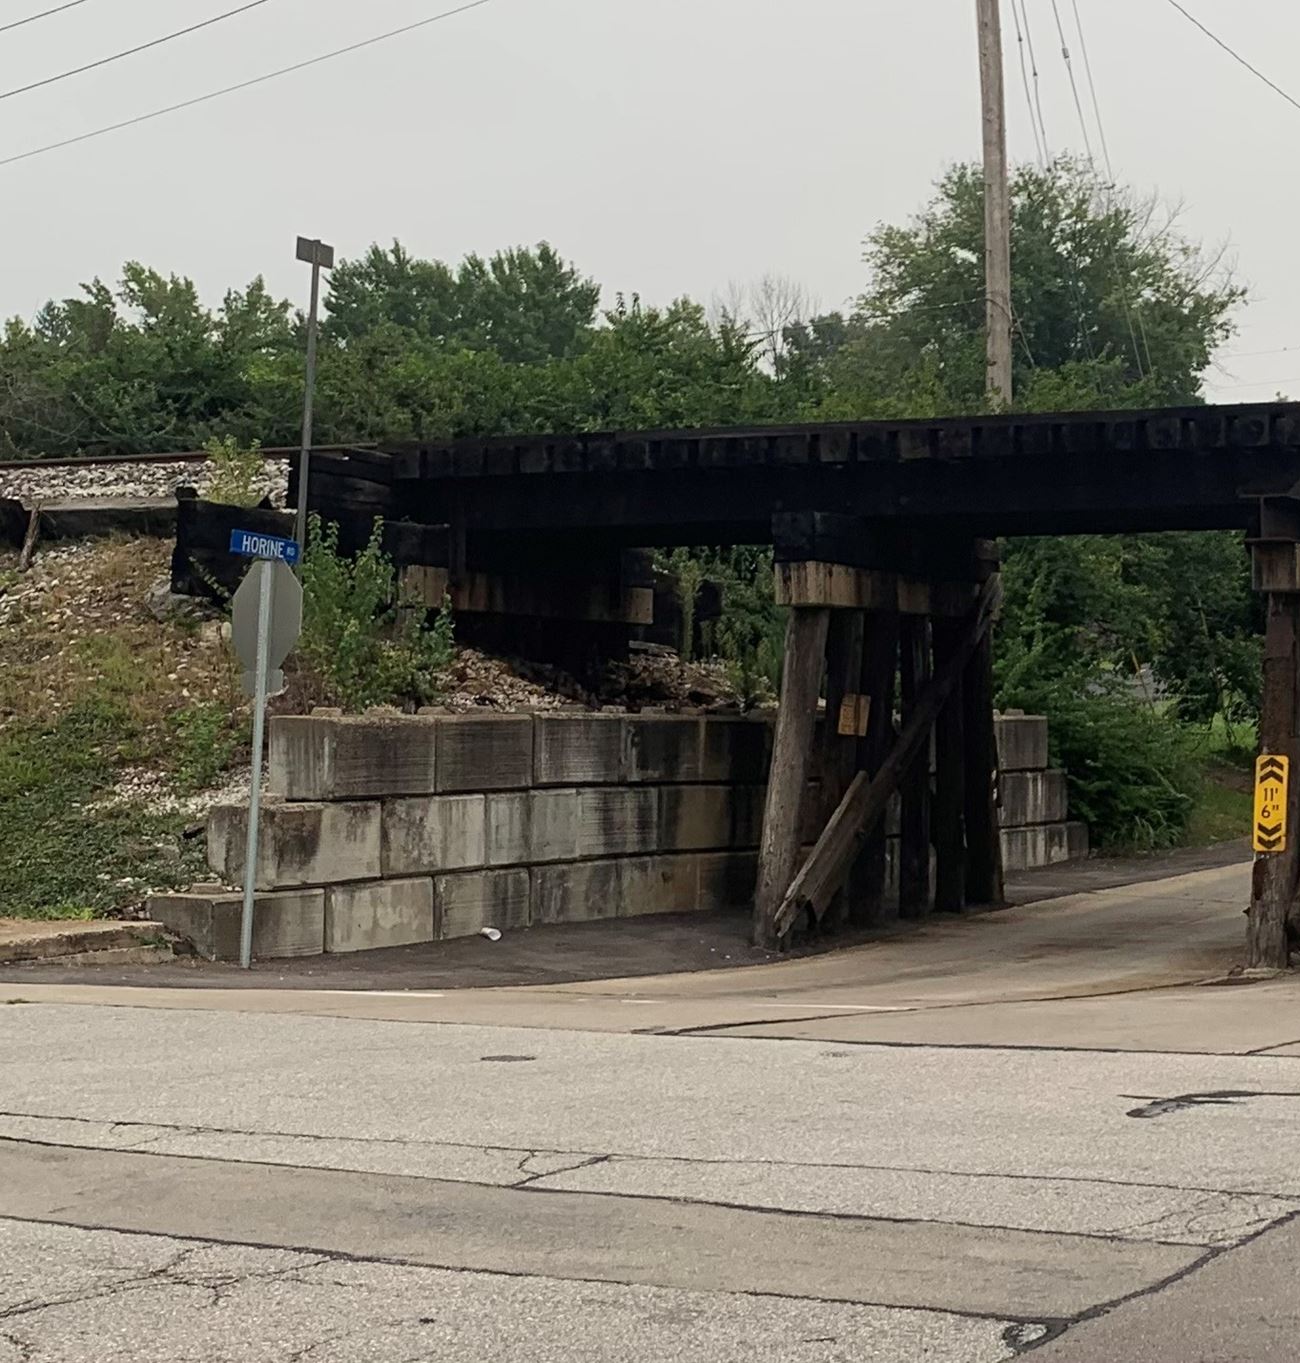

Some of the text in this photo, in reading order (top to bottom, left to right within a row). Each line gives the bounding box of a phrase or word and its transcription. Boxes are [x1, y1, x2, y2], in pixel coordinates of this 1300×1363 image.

[242, 534, 285, 558] HORINE
[1263, 787, 1279, 802] 11'
[1261, 804, 1280, 819] 6"
